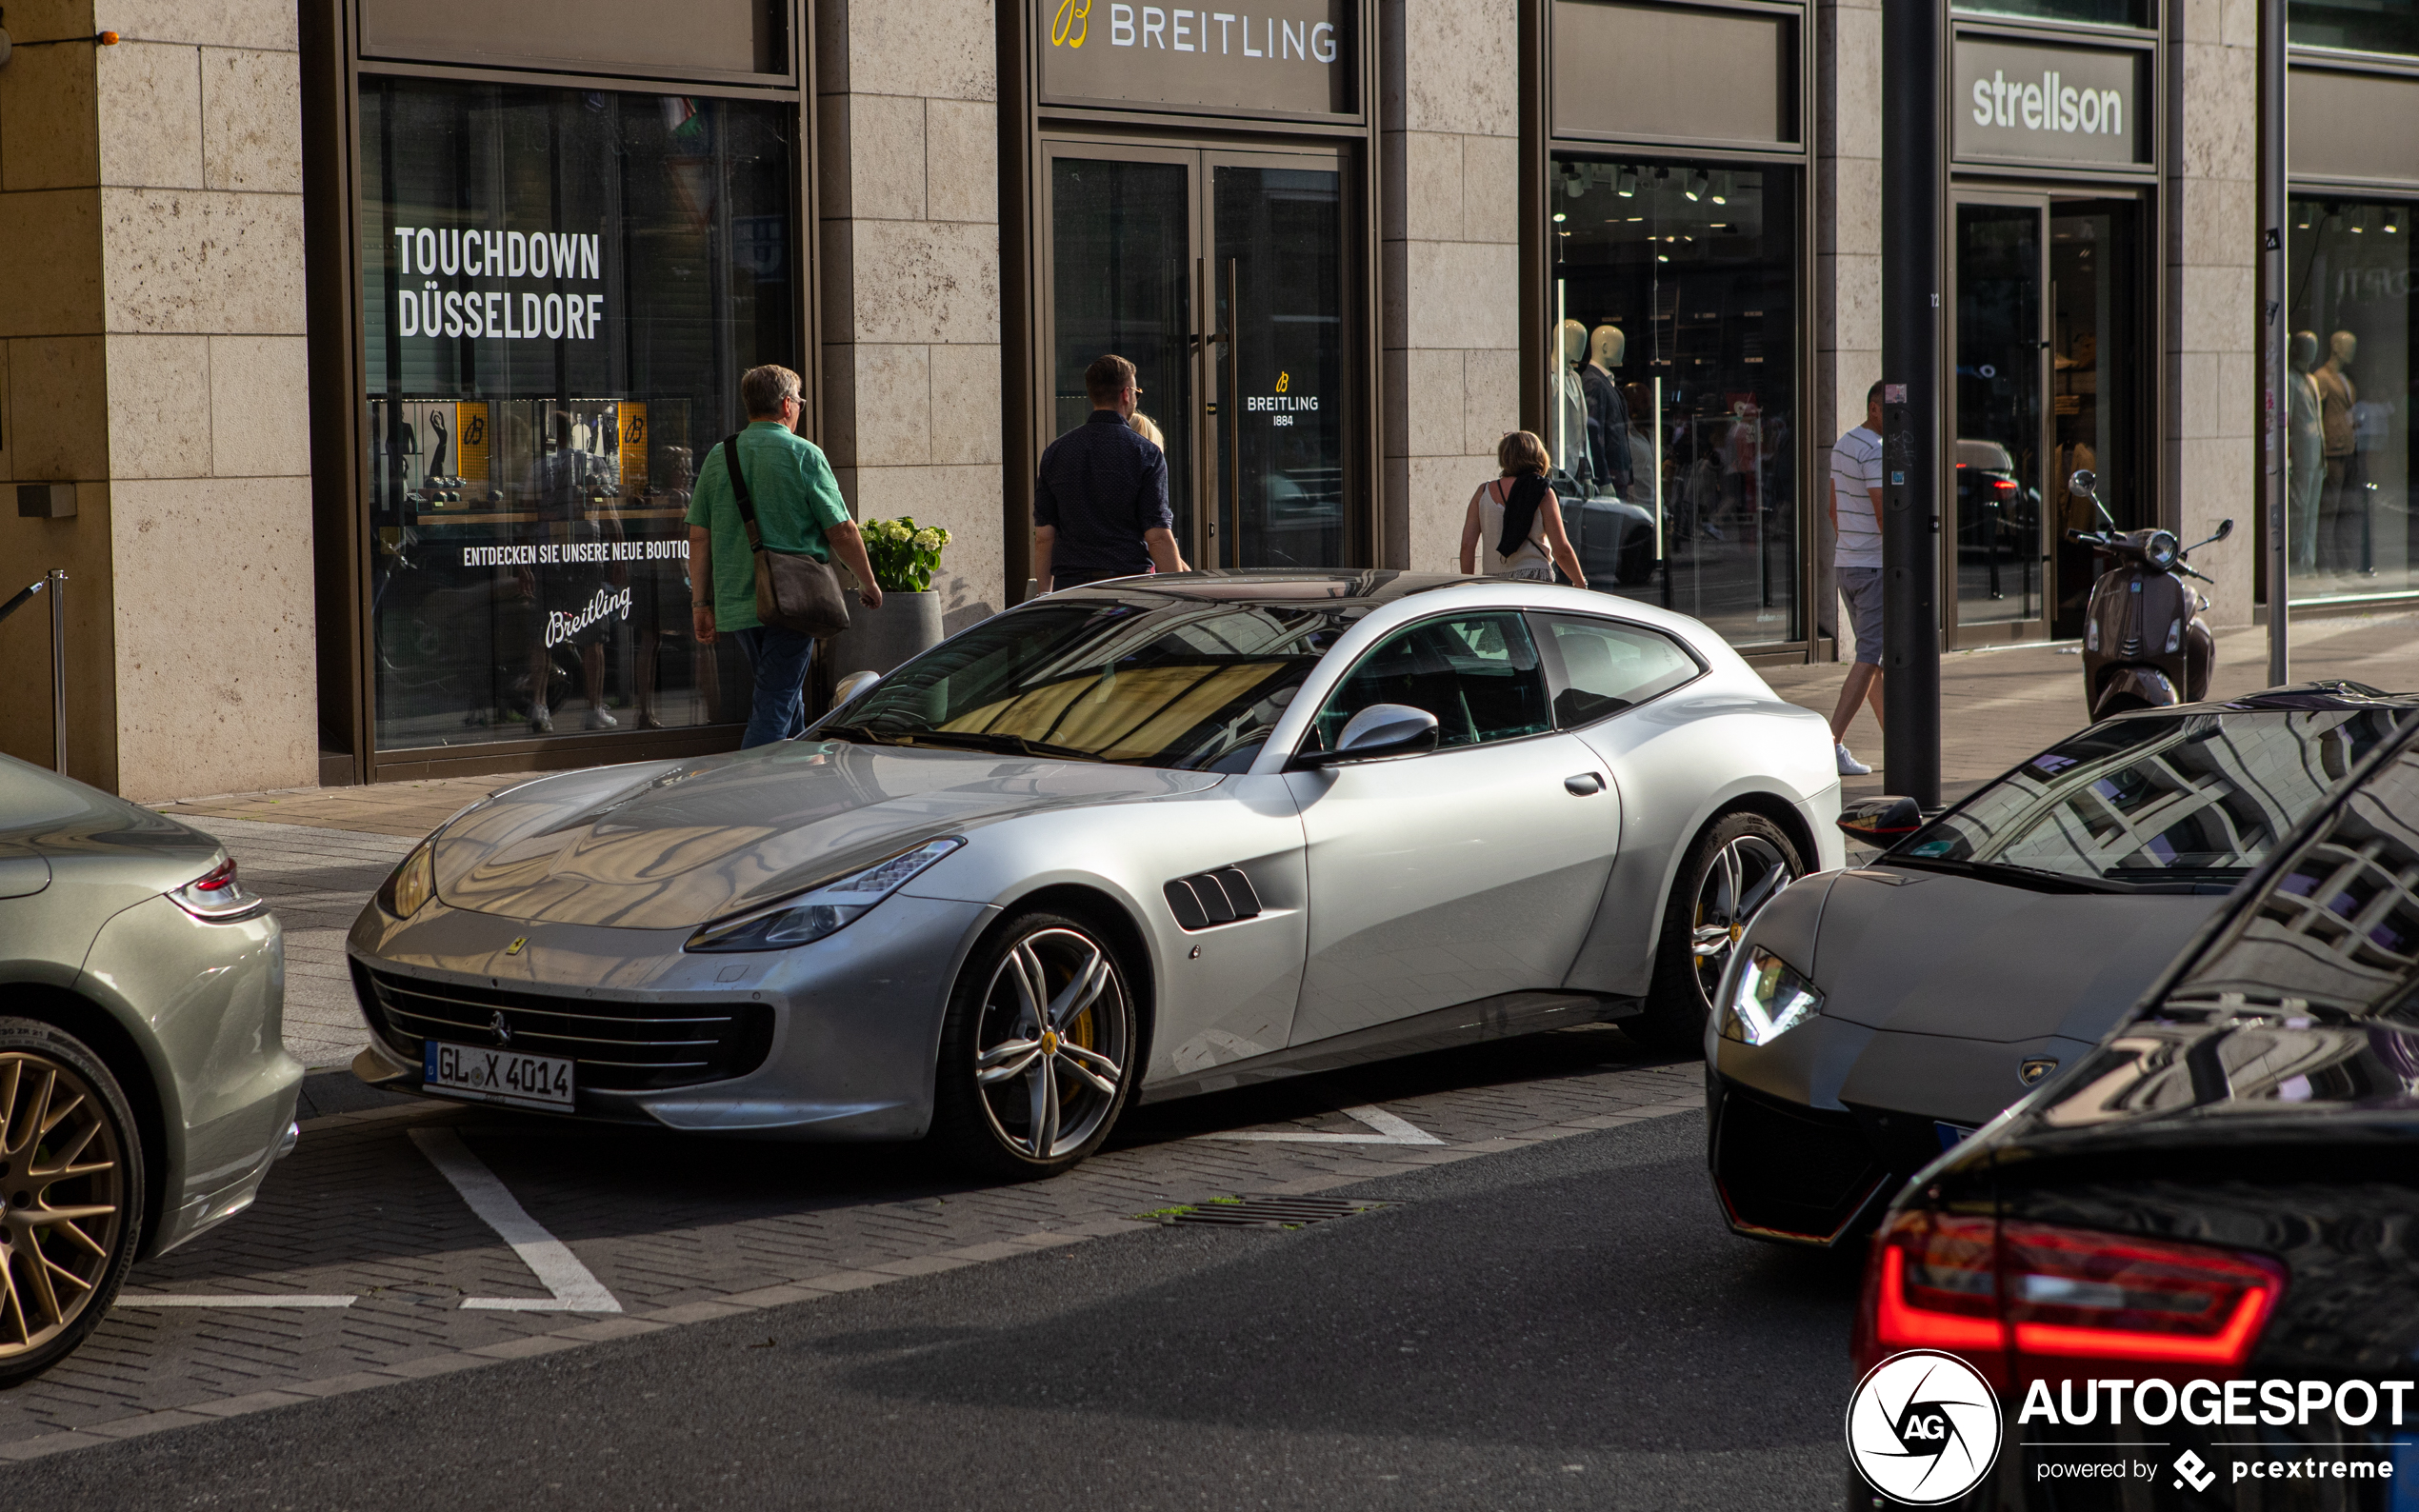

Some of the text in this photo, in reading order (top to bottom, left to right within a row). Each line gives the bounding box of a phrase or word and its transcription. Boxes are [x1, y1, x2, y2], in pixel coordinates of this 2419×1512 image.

[1111, 3, 1337, 63] BREITLING
[1972, 70, 2122, 135] strellson
[394, 227, 600, 279] TOUCHDOWN
[398, 280, 604, 340] DÜSSELDORF
[1248, 396, 1318, 411] BREITLING
[1273, 415, 1293, 426] 1884
[464, 545, 536, 567] ENTDECKEN
[539, 544, 560, 564] SIE
[562, 542, 610, 563] UNSERE
[612, 541, 644, 561] NEUE
[545, 587, 633, 648] Breitling
[440, 1047, 469, 1083] GL
[485, 1053, 499, 1087] X
[506, 1058, 569, 1097] 4014
